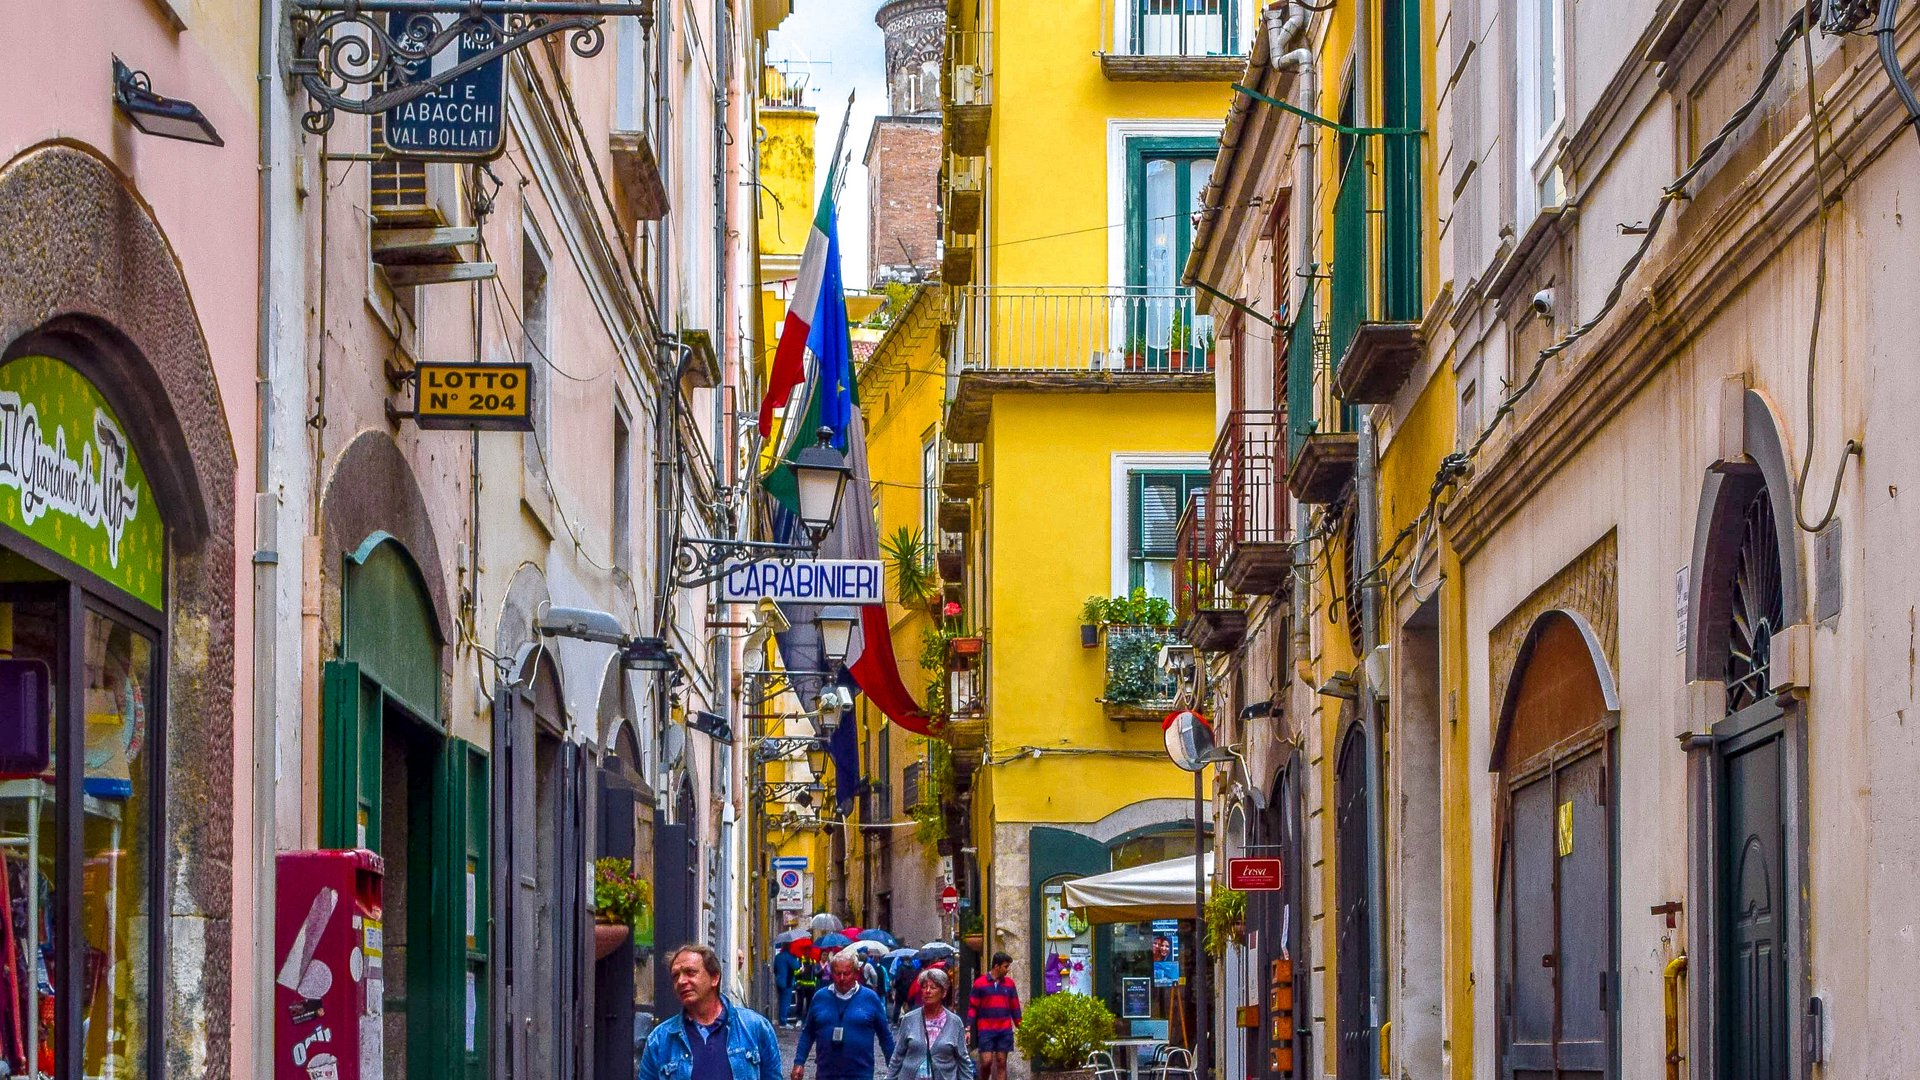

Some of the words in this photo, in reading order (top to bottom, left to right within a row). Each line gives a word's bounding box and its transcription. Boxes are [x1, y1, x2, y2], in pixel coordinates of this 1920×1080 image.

[465, 85, 476, 100] E
[392, 127, 423, 146] VAL.
[428, 128, 492, 147] BOLLATI
[428, 371, 519, 389] LOTTO
[430, 392, 458, 409] N°
[469, 394, 516, 410] 204
[21, 415, 78, 513] Giardino
[80, 453, 97, 516] di
[728, 563, 878, 599] CARABINIERI
